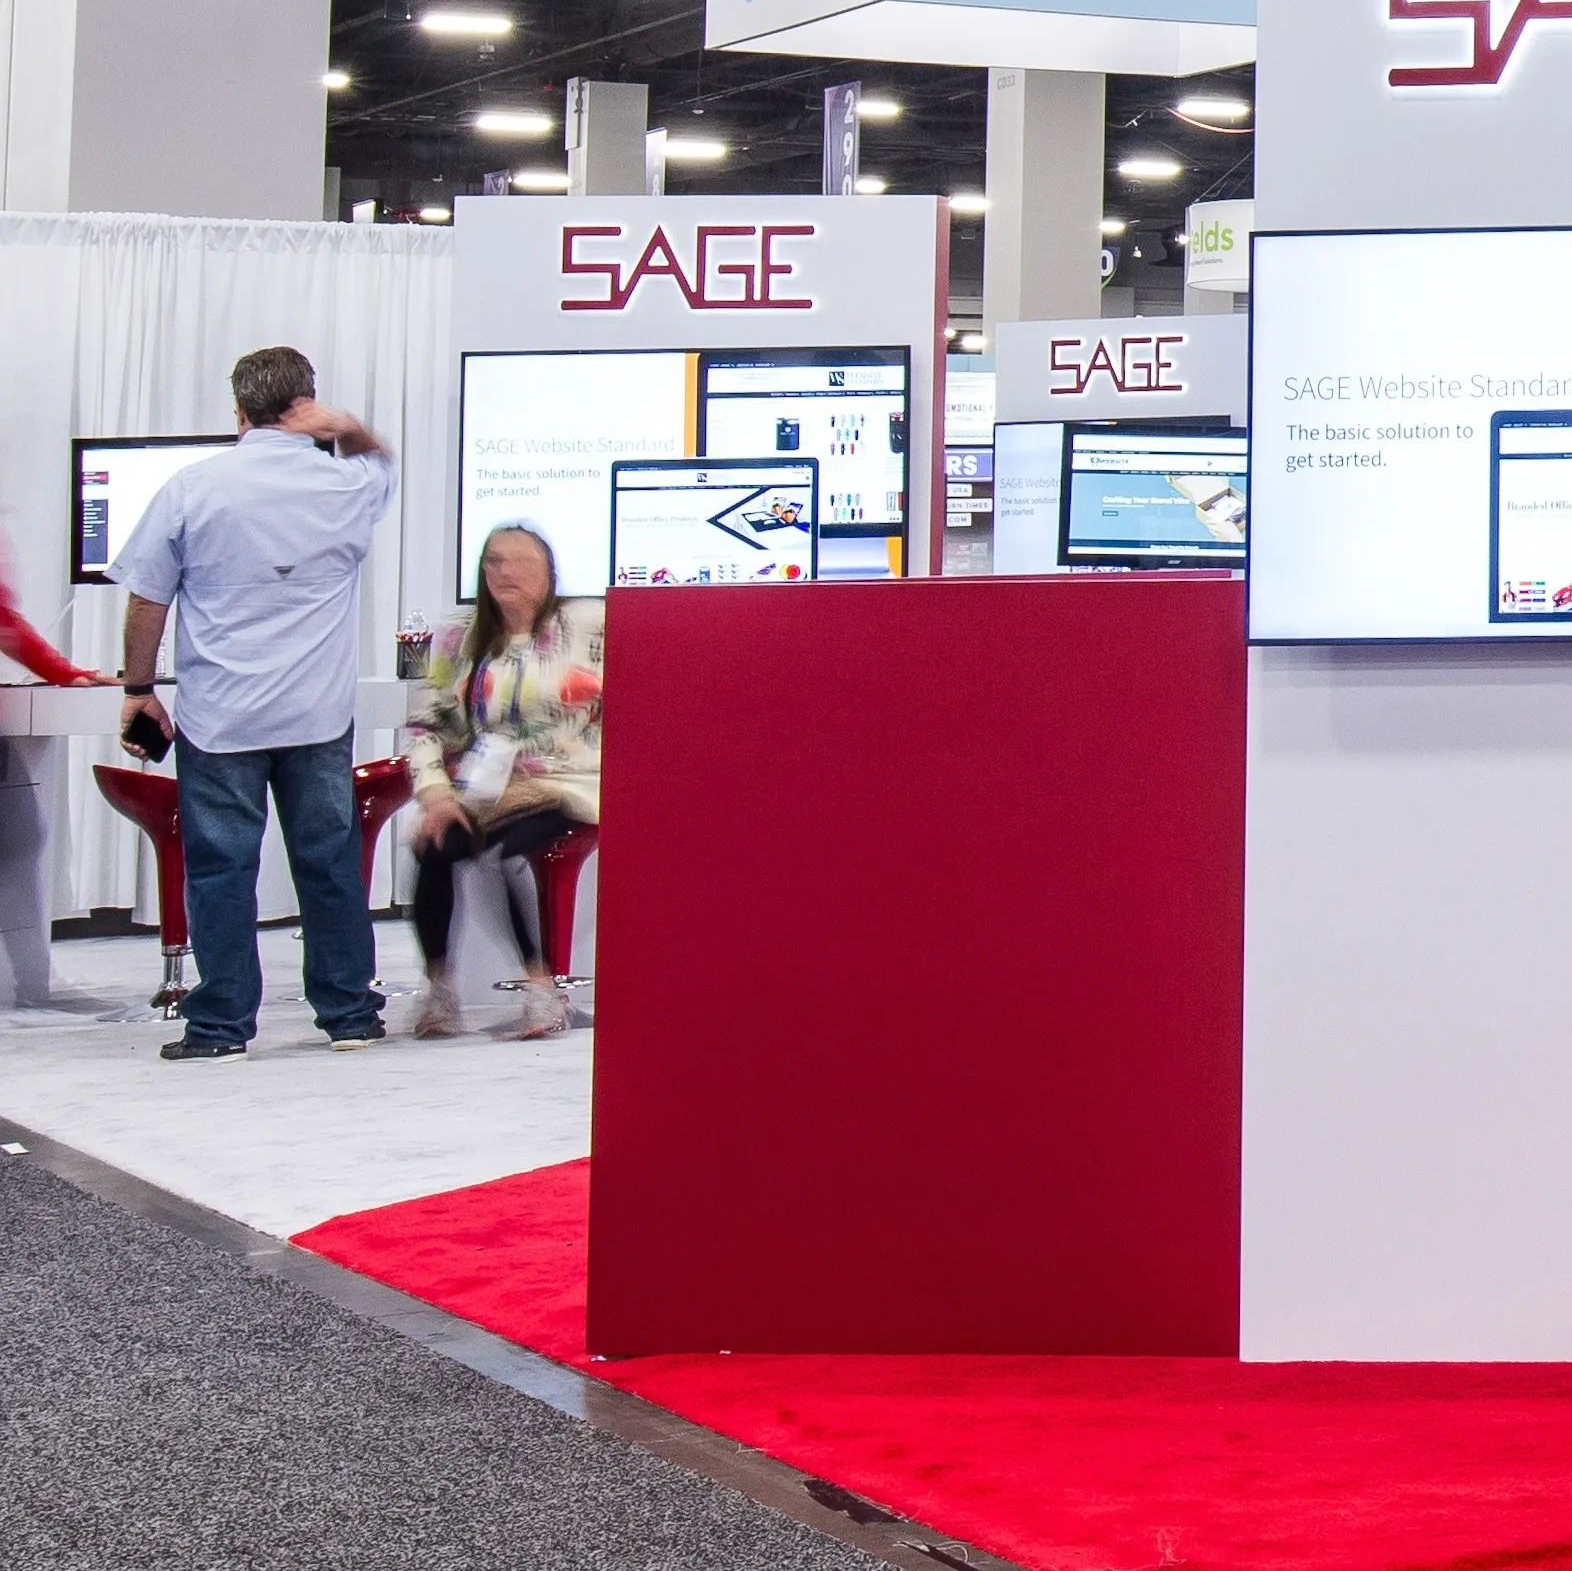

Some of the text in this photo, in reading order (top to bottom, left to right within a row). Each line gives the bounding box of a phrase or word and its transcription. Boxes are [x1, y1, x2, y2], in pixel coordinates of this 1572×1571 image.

[560, 225, 815, 311] SAGE
[1050, 336, 1184, 395] SAGE
[1283, 376, 1351, 401] SAGE
[1359, 374, 1462, 400] Website
[1286, 423, 1474, 441] The basic solution to
[474, 436, 675, 455] SAGE Website Standard
[1286, 450, 1388, 473] get started.
[477, 467, 601, 480] The basic solution to
[476, 485, 543, 500] get started.
[1000, 478, 1023, 489] SAGE
[1001, 496, 1058, 505] The basic solution
[1507, 500, 1548, 510] Branded
